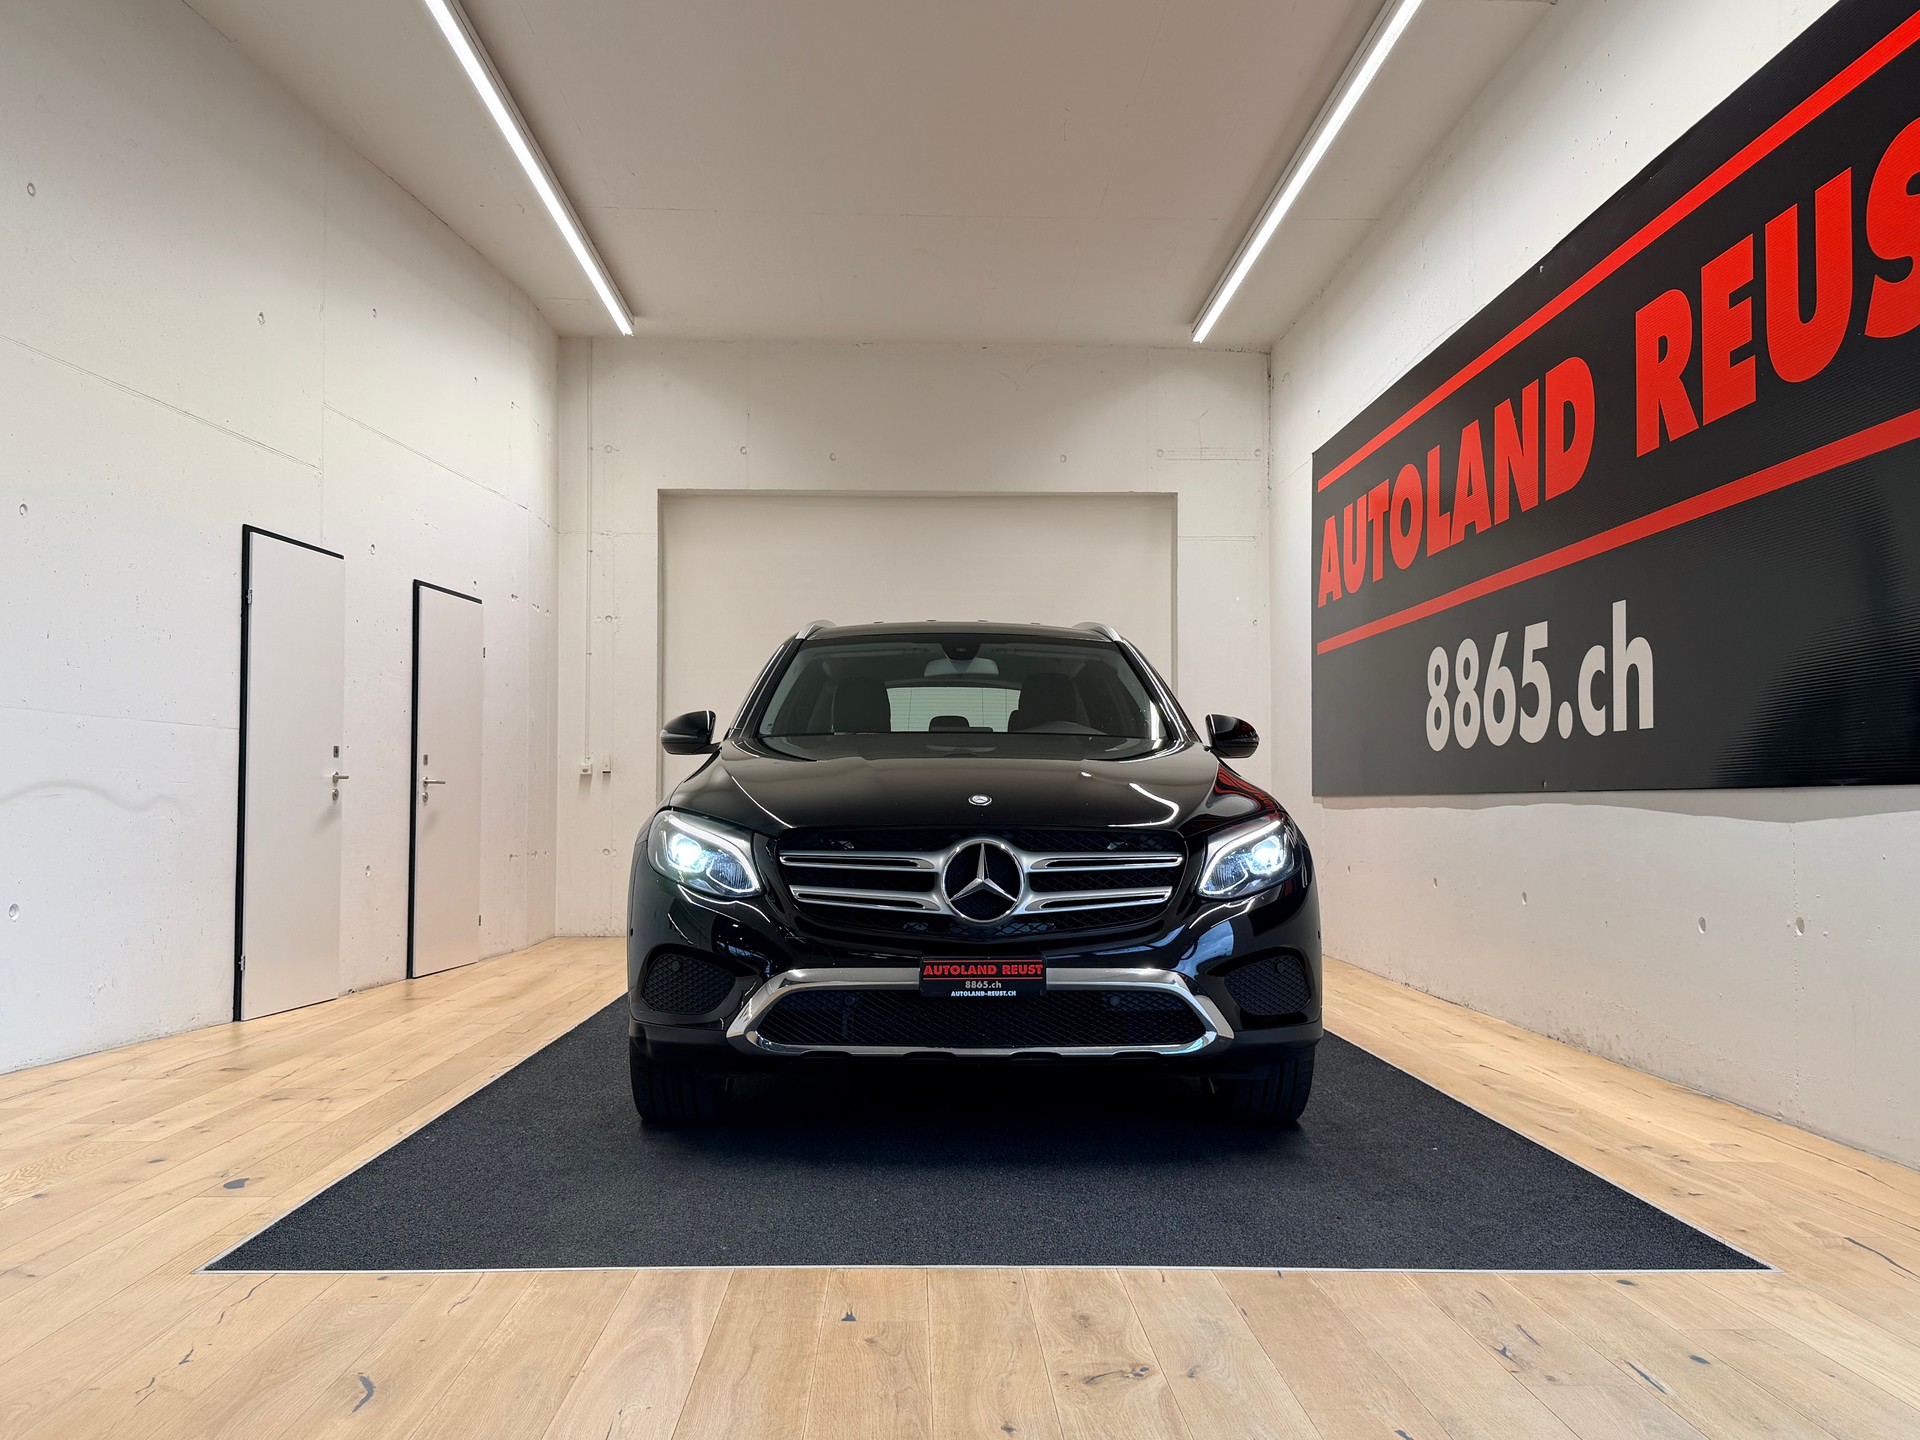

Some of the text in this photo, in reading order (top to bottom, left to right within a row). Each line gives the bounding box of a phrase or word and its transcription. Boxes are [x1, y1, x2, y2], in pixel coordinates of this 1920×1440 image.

[1317, 356, 1595, 608] AUTOLAND
[1425, 599, 1654, 752] 8865.ch
[923, 964, 1043, 976] AUTOLAND REUST
[965, 981, 1002, 989] 8865.ch
